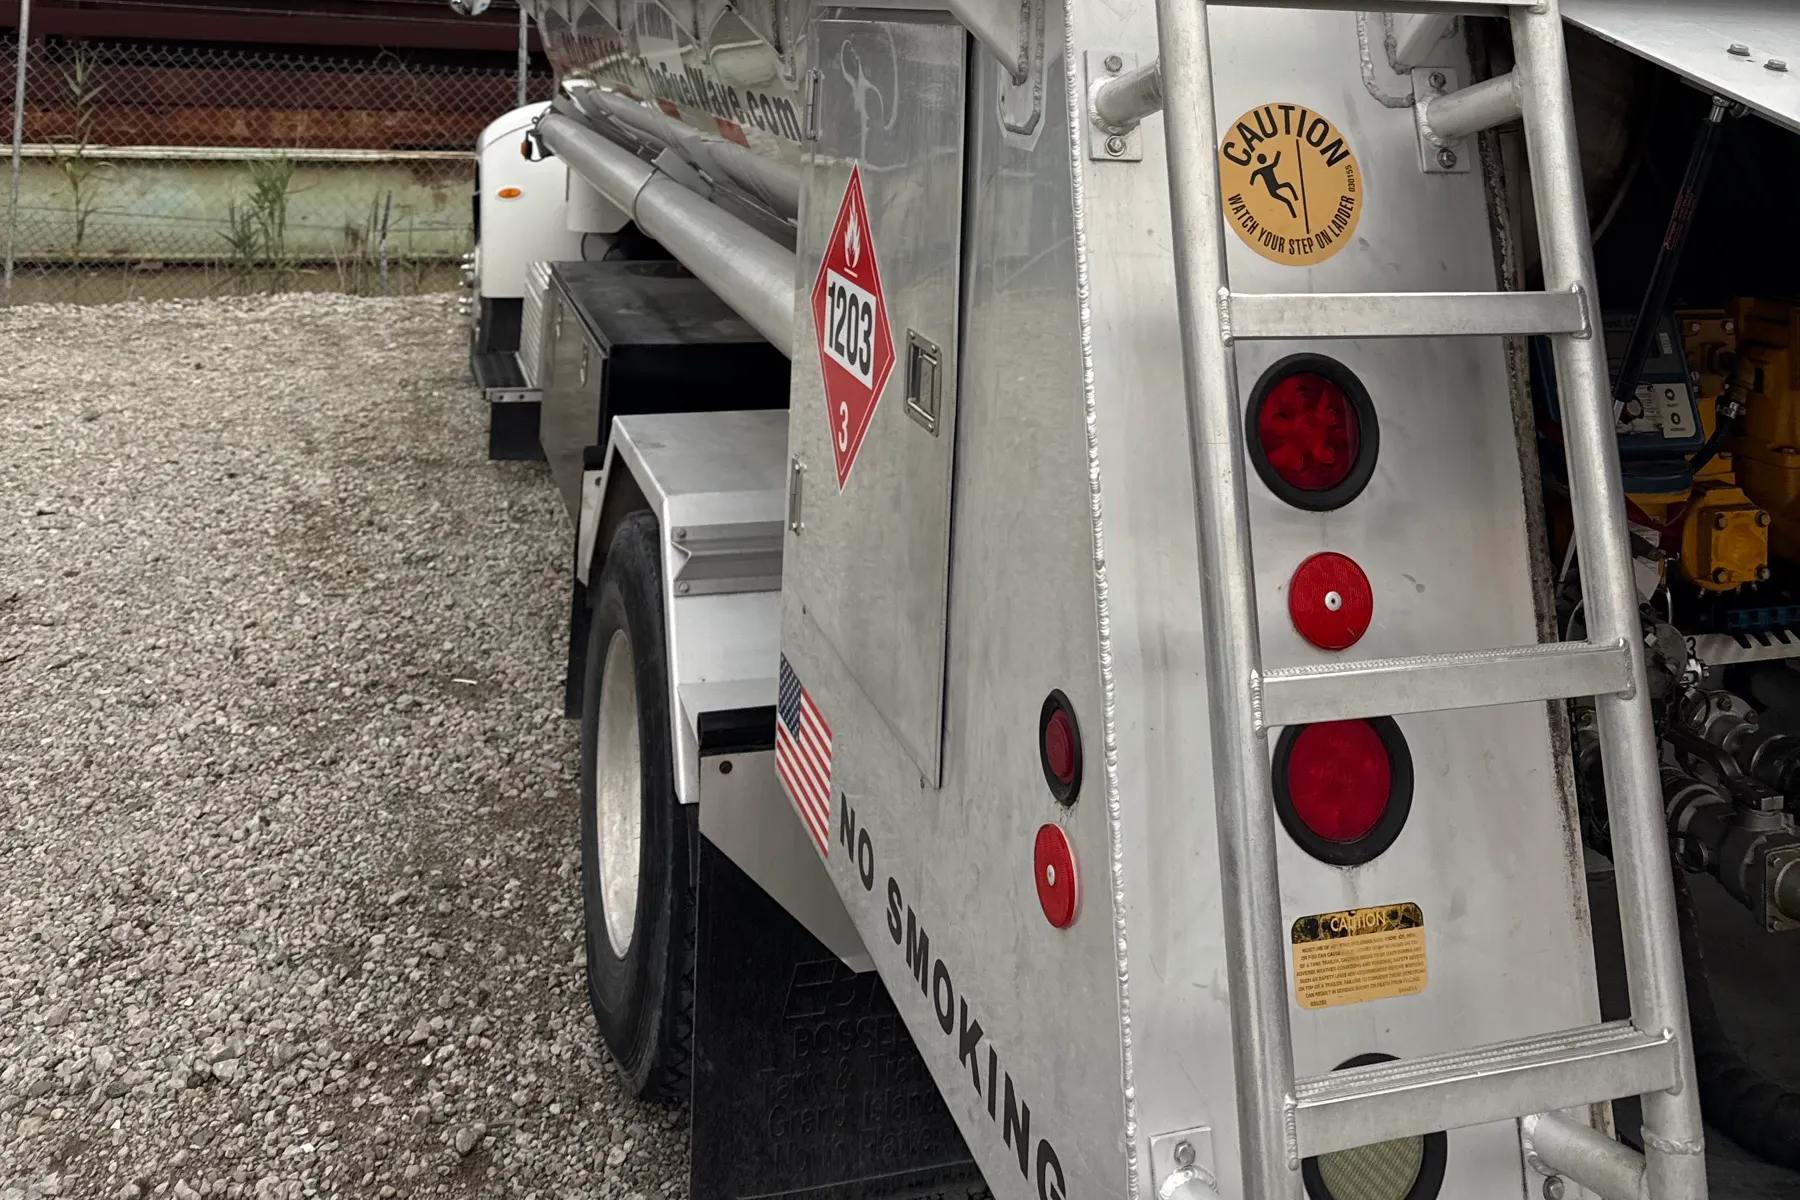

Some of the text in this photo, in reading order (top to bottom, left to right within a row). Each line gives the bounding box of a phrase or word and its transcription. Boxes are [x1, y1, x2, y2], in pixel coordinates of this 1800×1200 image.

[1223, 105, 1350, 168] CAUTION
[1345, 164, 1356, 193] 030155
[1228, 193, 1355, 255] WATCH YOUR STEP ON LADDER
[827, 281, 873, 377] 1203
[838, 400, 849, 453] 3
[1330, 912, 1387, 933] CAUTION
[840, 791, 1067, 1200] NO SMOKING
